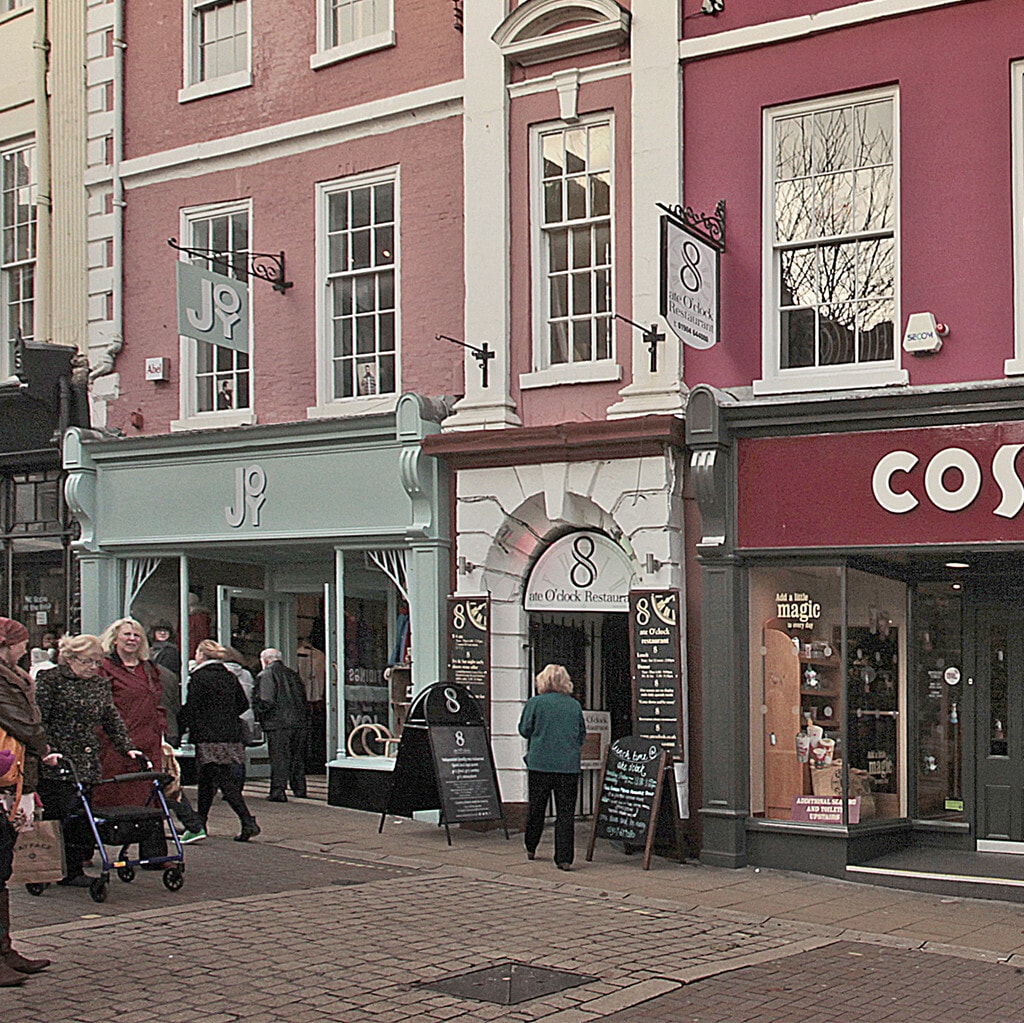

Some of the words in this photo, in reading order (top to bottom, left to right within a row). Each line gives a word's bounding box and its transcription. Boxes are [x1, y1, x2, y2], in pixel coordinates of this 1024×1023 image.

[680, 241, 702, 292] 8
[186, 278, 241, 340] JOY
[669, 301, 714, 334] Restaurant
[224, 464, 267, 529] JOY
[570, 535, 597, 588] 8
[529, 591, 544, 602] ate
[545, 588, 581, 602] O'clock
[453, 604, 465, 629] 8
[635, 598, 651, 626] 8
[777, 600, 821, 623] magic
[444, 687, 460, 713] 8
[455, 730, 465, 747] 8
[796, 797, 831, 805] ADDITIONAL
[806, 805, 820, 813] AND
[809, 813, 841, 821] UPSTAIRS
